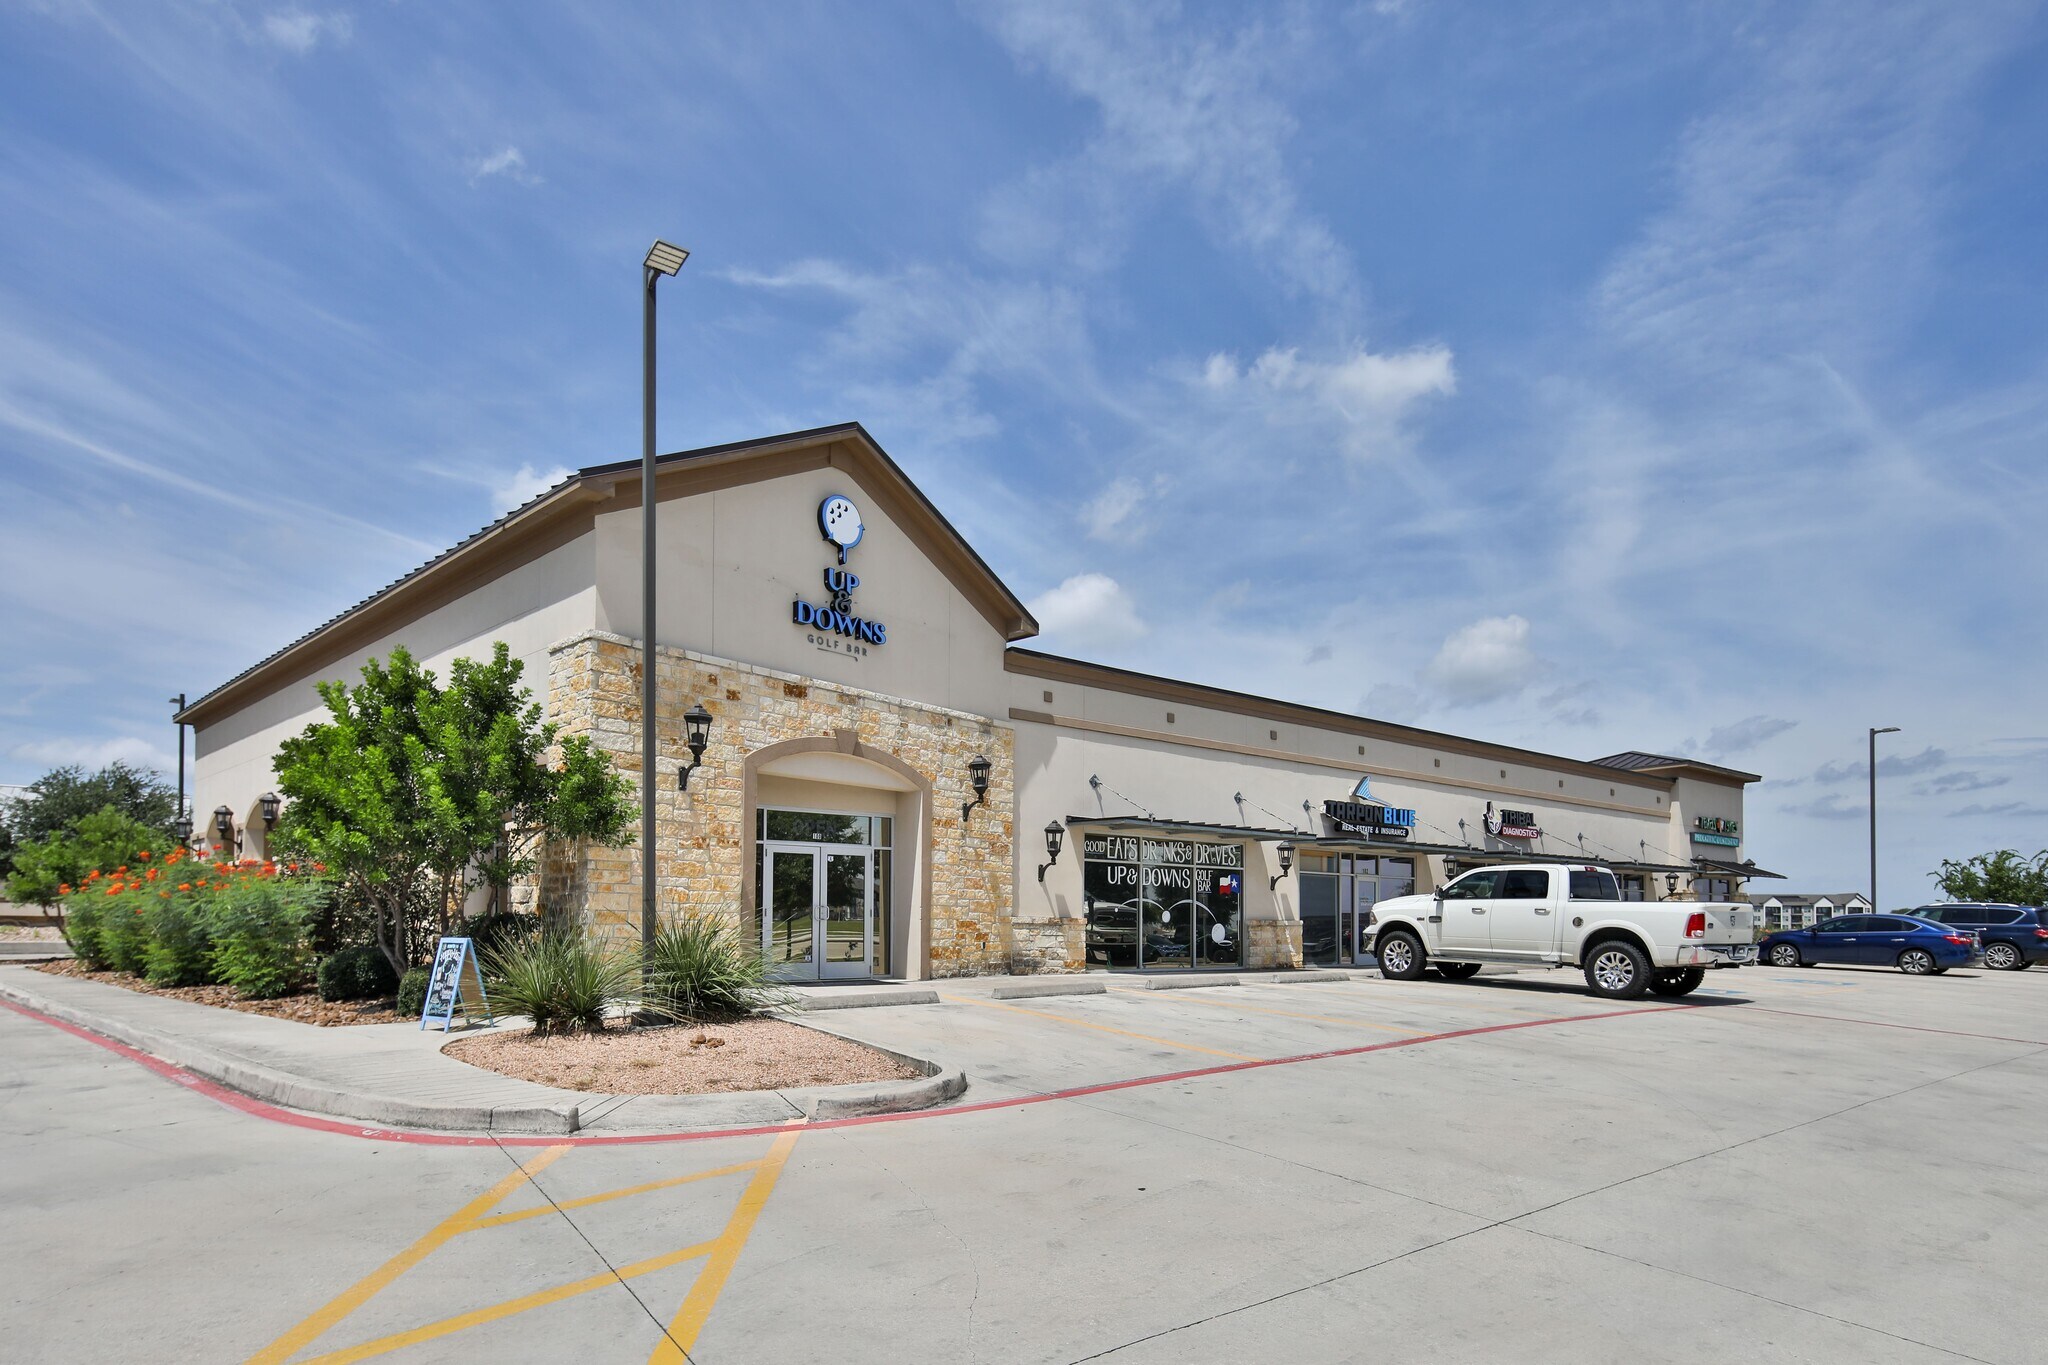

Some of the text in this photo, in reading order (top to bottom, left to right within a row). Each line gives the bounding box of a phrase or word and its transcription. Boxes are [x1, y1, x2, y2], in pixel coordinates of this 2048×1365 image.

[824, 567, 860, 596] UP
[832, 589, 852, 616] &
[793, 600, 887, 645] DOWNS
[807, 634, 868, 657] GOLF BAR
[1380, 827, 1406, 837] INSURANCE
[1502, 827, 1538, 838] DIAGNOSTICS
[1085, 841, 1105, 852] GOOD
[1107, 837, 1137, 860] EATS
[1143, 840, 1185, 863] DRNKS
[1186, 845, 1192, 860] &
[1107, 866, 1190, 889] UP & DOWNS
[1195, 870, 1213, 881] GOLF
[1197, 880, 1211, 892] BAR
